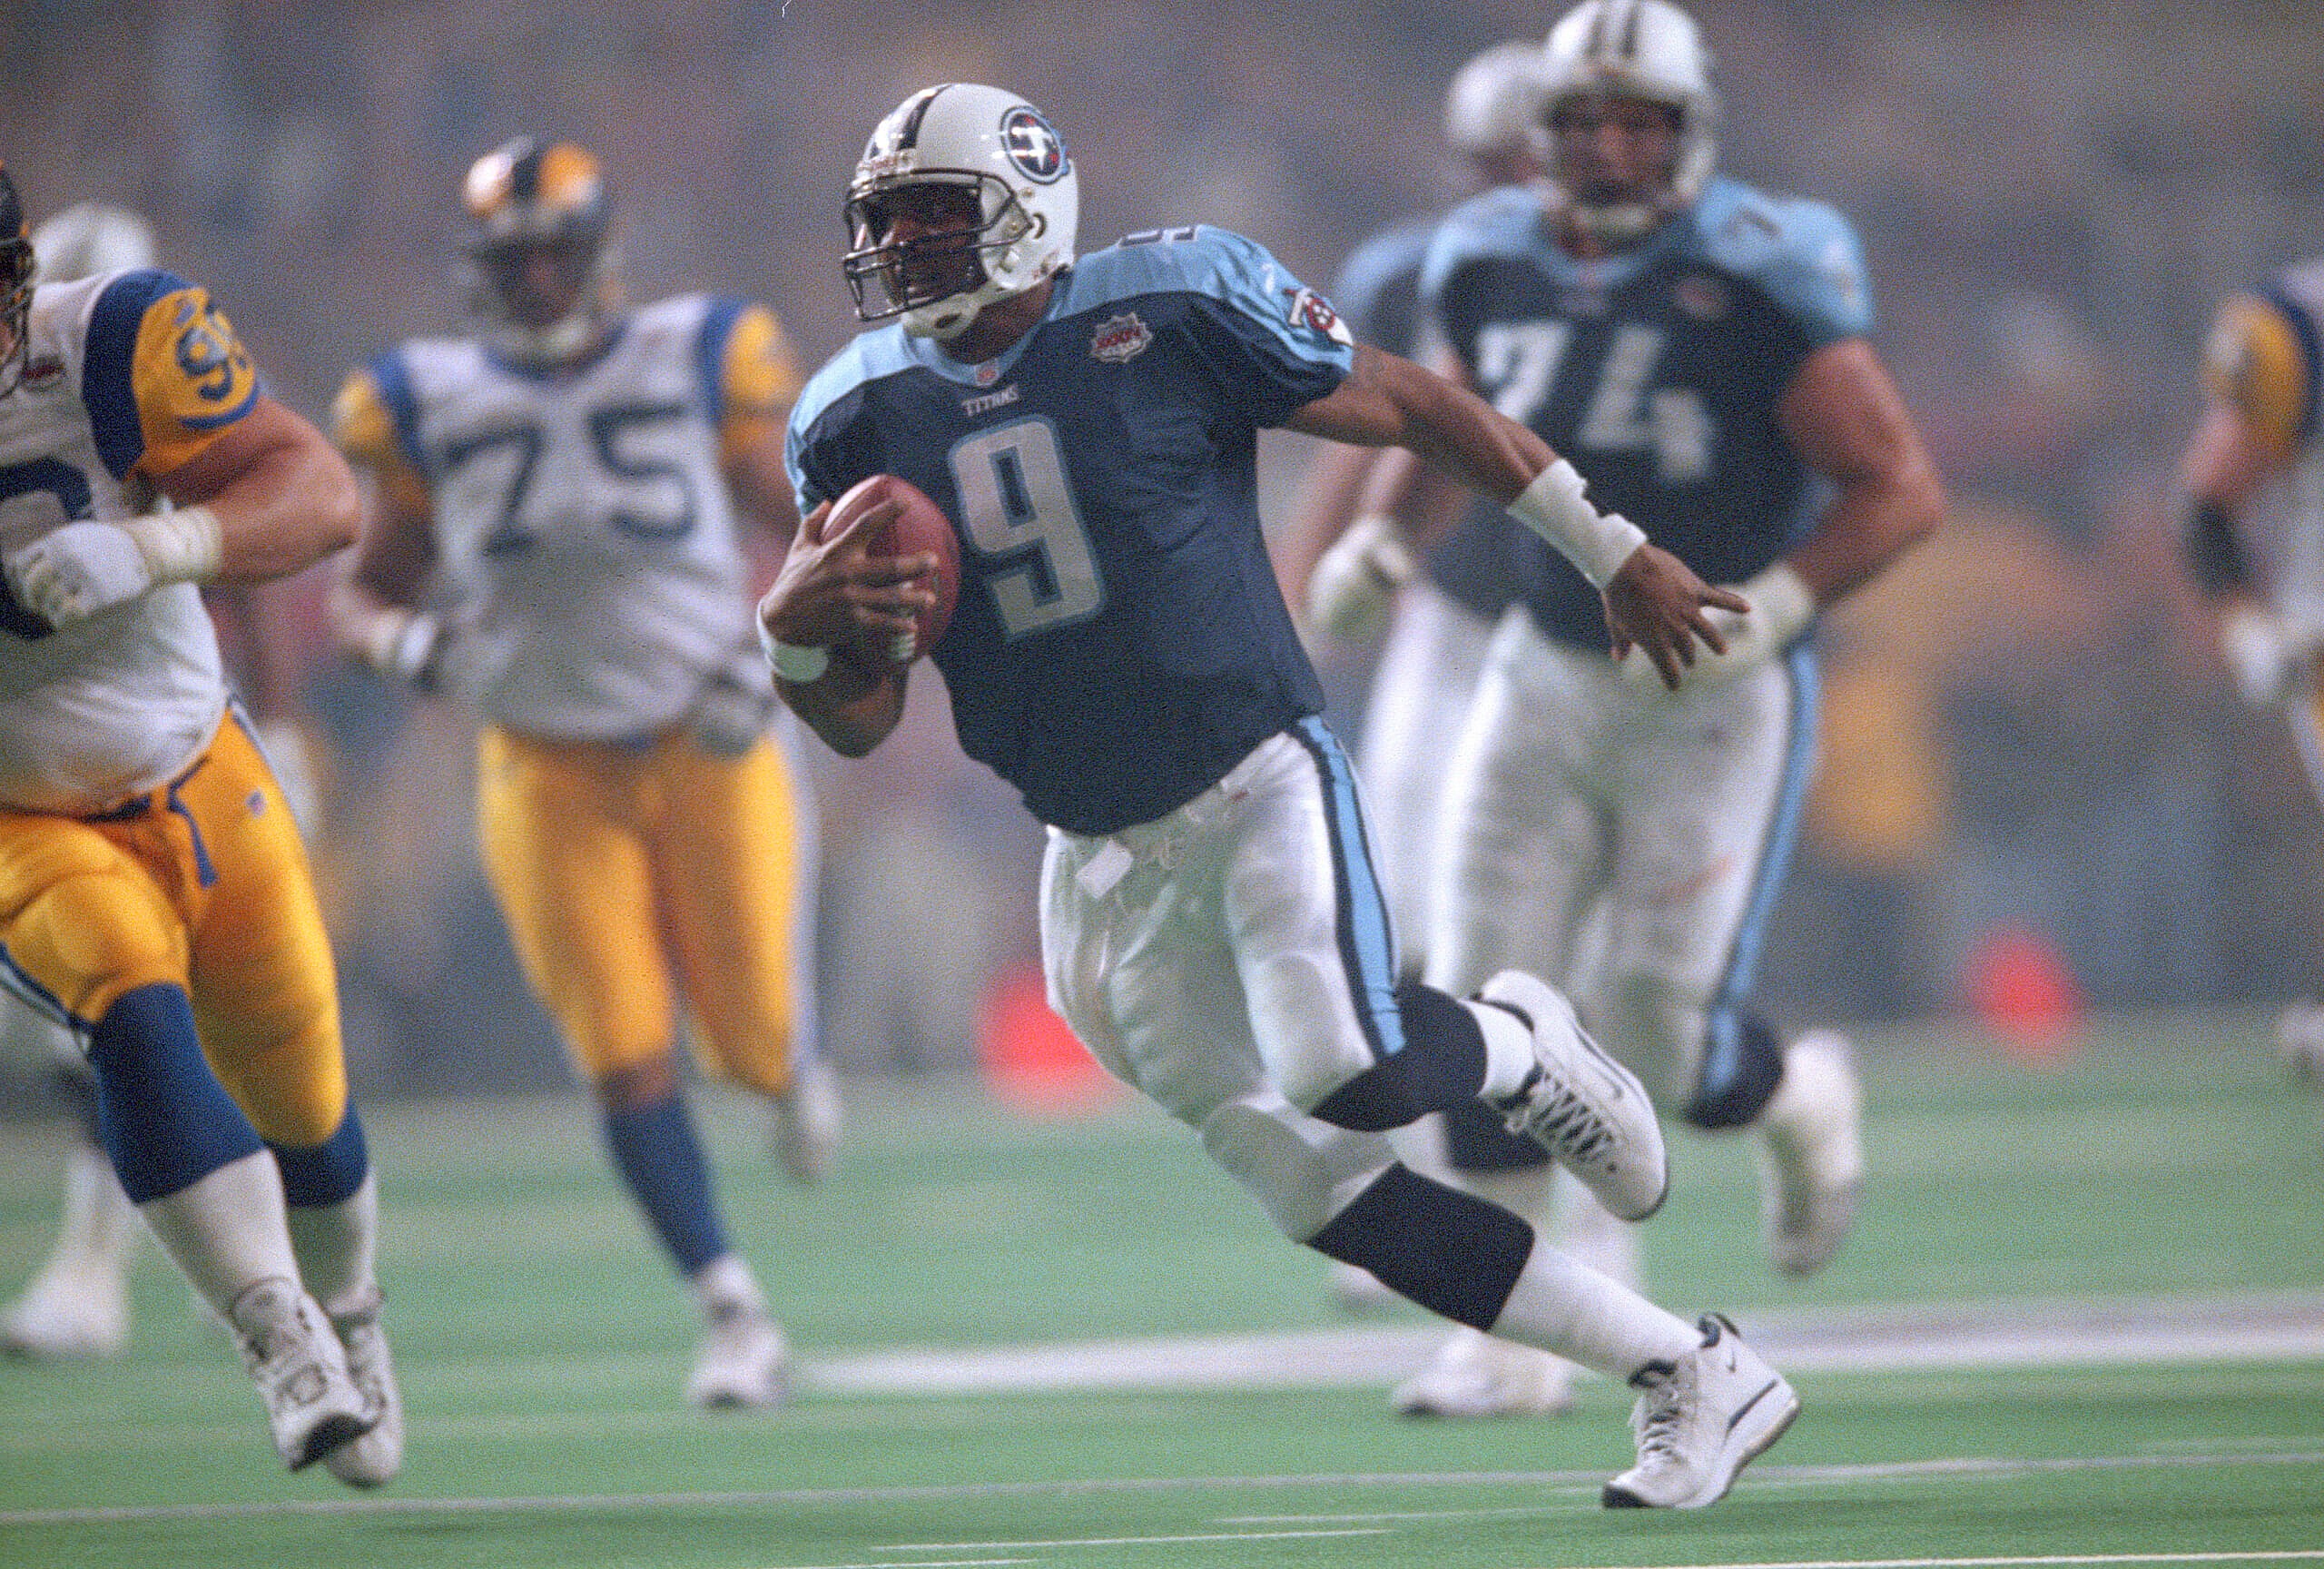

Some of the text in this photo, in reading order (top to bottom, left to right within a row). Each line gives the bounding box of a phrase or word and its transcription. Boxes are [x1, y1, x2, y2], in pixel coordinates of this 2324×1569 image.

[444, 401, 697, 556] 75
[961, 383, 1019, 417] TITANS
[1474, 320, 1718, 483] 74
[949, 415, 1104, 640] 9
